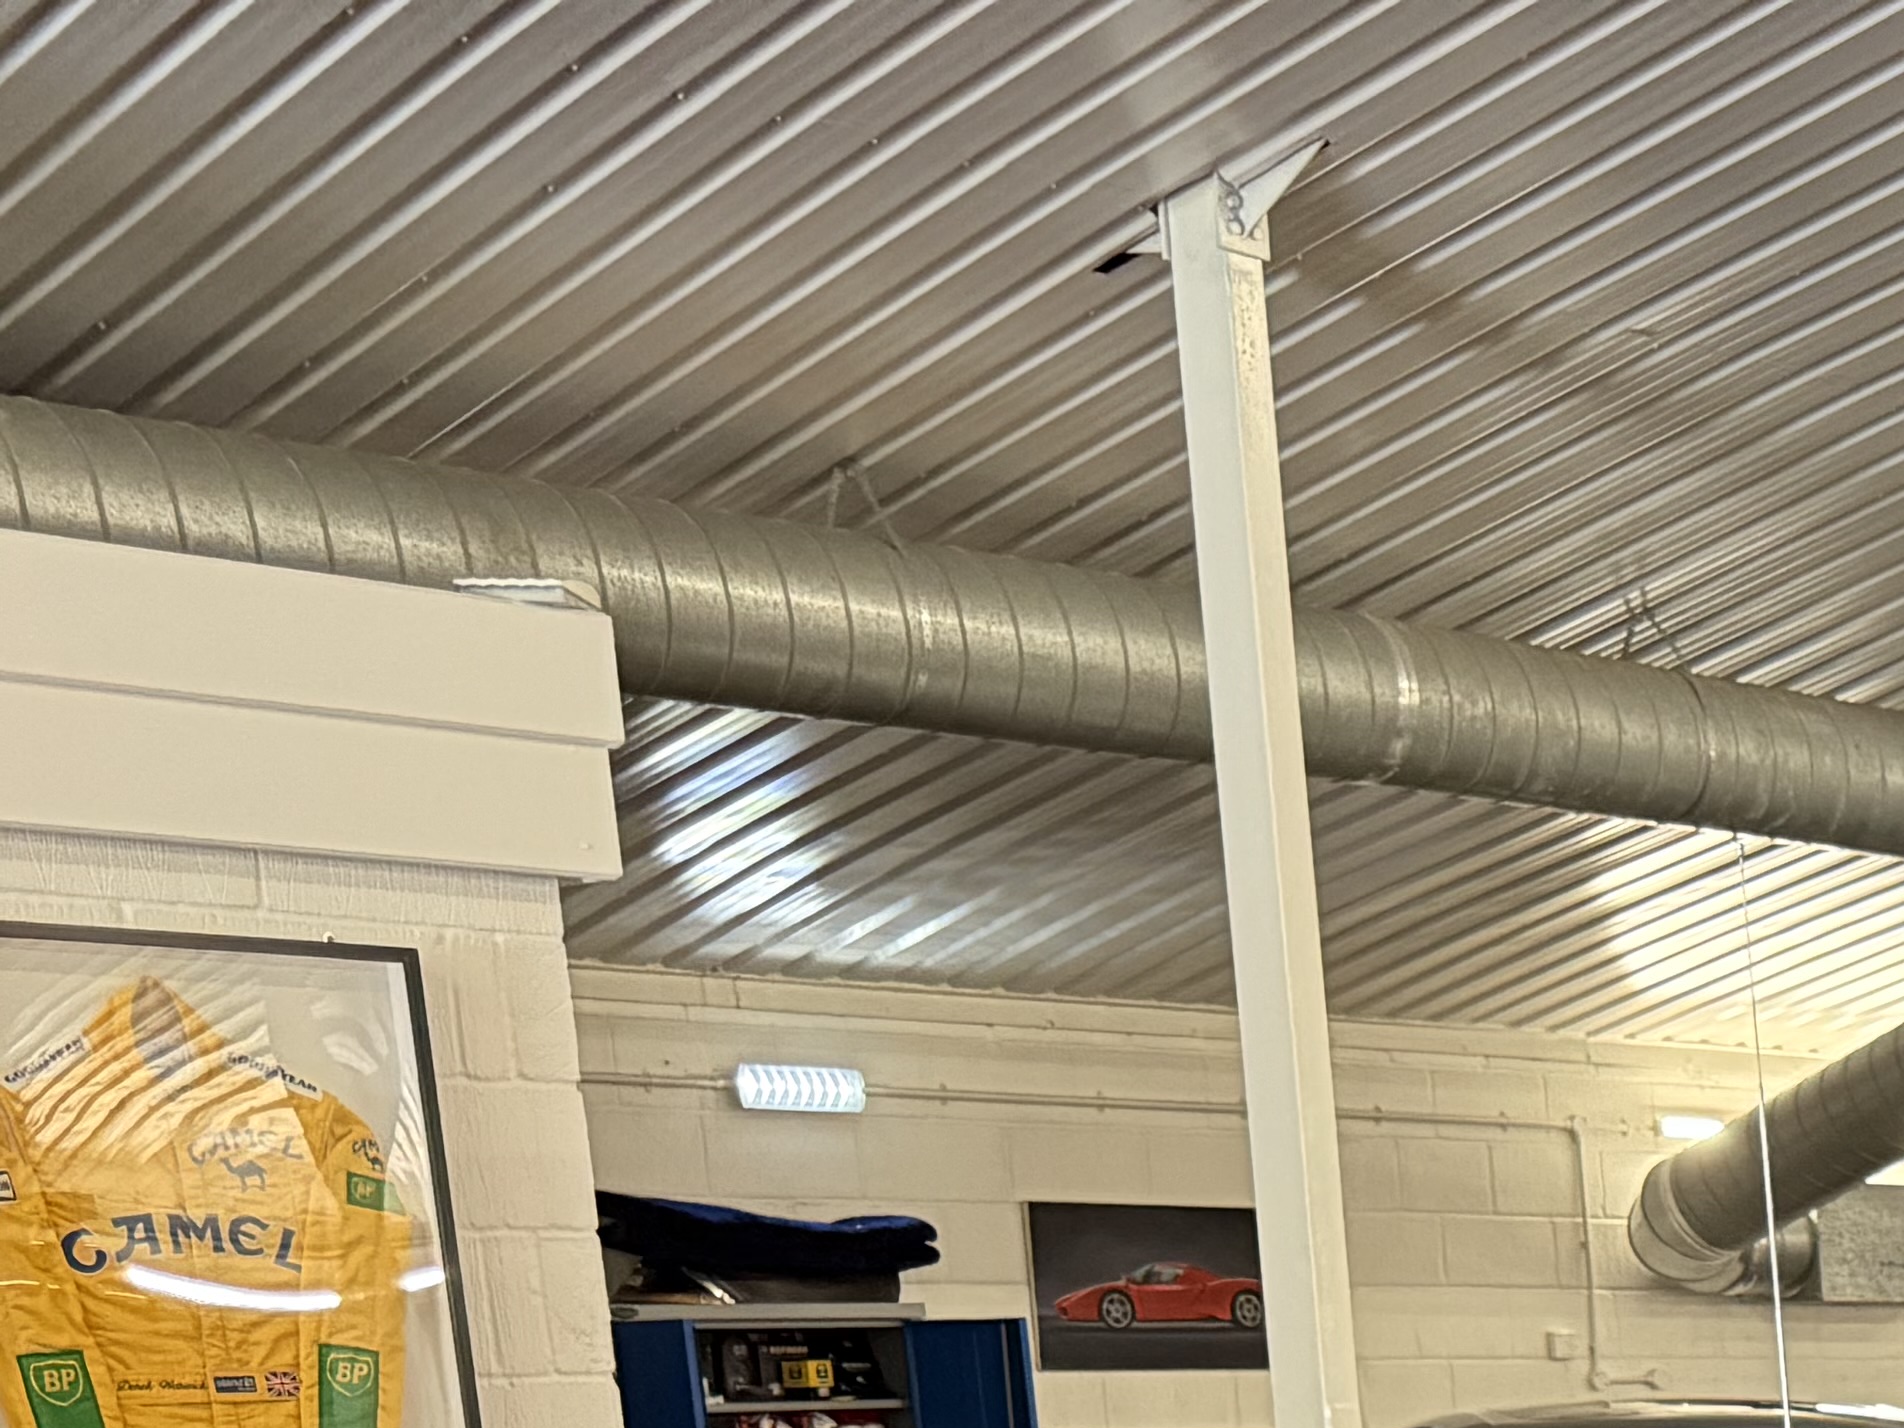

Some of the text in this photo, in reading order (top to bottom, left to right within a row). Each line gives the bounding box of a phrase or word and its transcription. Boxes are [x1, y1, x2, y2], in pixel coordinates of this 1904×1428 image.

[187, 1126, 304, 1167] CAMEL
[61, 1213, 303, 1275] CAMEL
[43, 1369, 76, 1393] BP
[336, 1361, 369, 1385] BP
